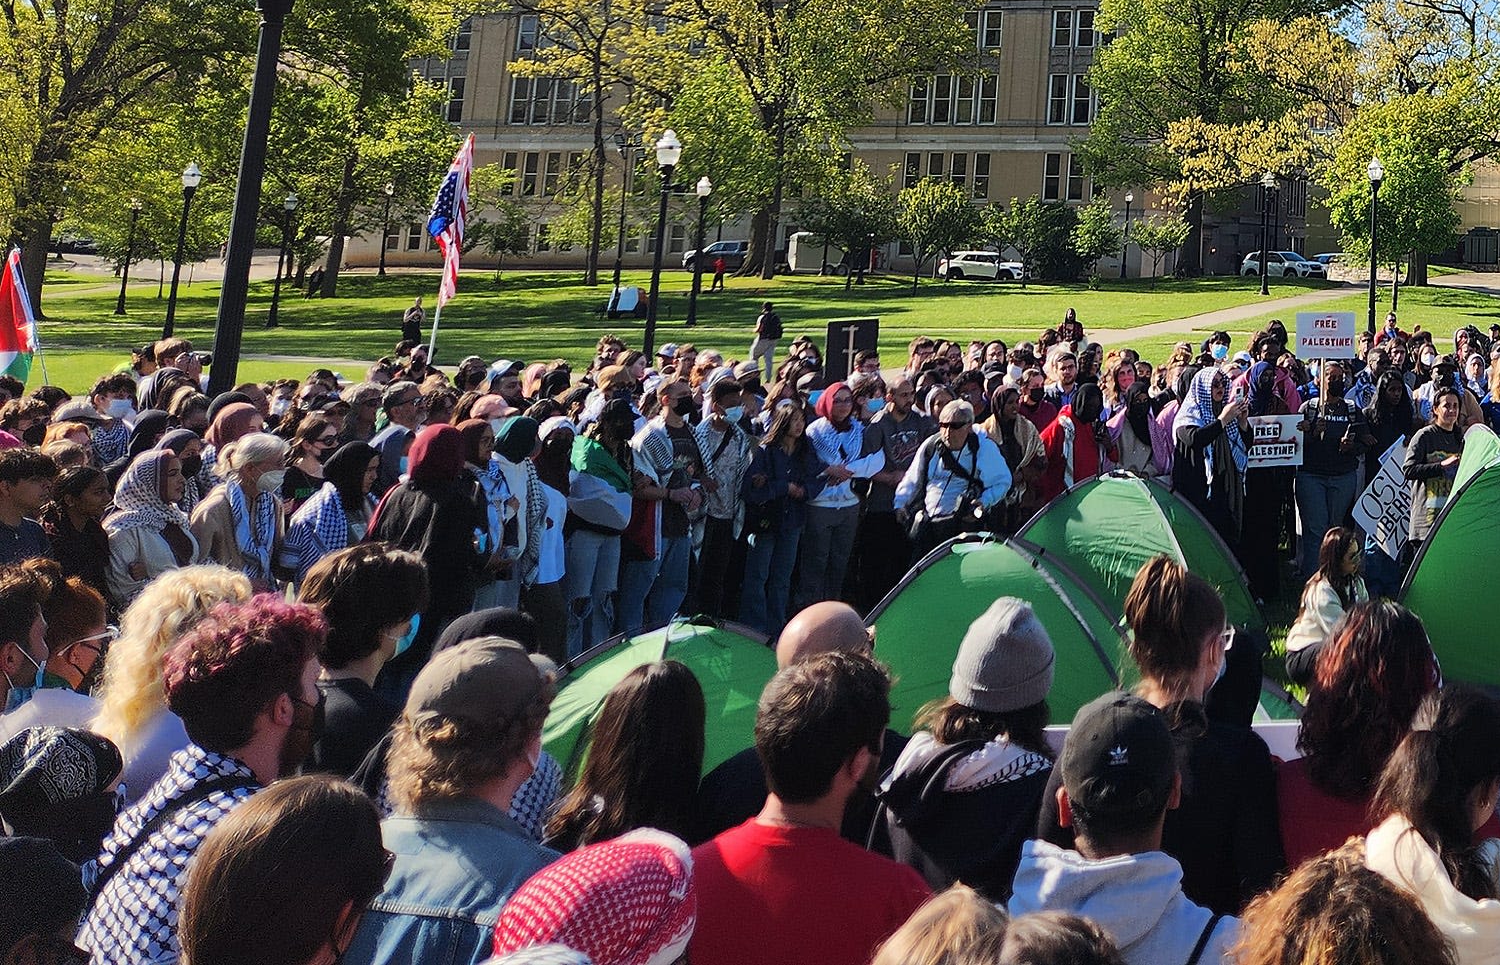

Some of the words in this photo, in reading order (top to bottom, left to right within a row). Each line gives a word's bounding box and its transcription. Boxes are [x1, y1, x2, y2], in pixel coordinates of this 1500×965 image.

[1314, 319, 1337, 329] FREE
[1255, 426, 1279, 437] FREE
[1249, 445, 1294, 457] ALESTINE
[1361, 456, 1406, 520] OSU
[1372, 479, 1412, 545] LIBERAT
[1388, 512, 1410, 551] ZO
